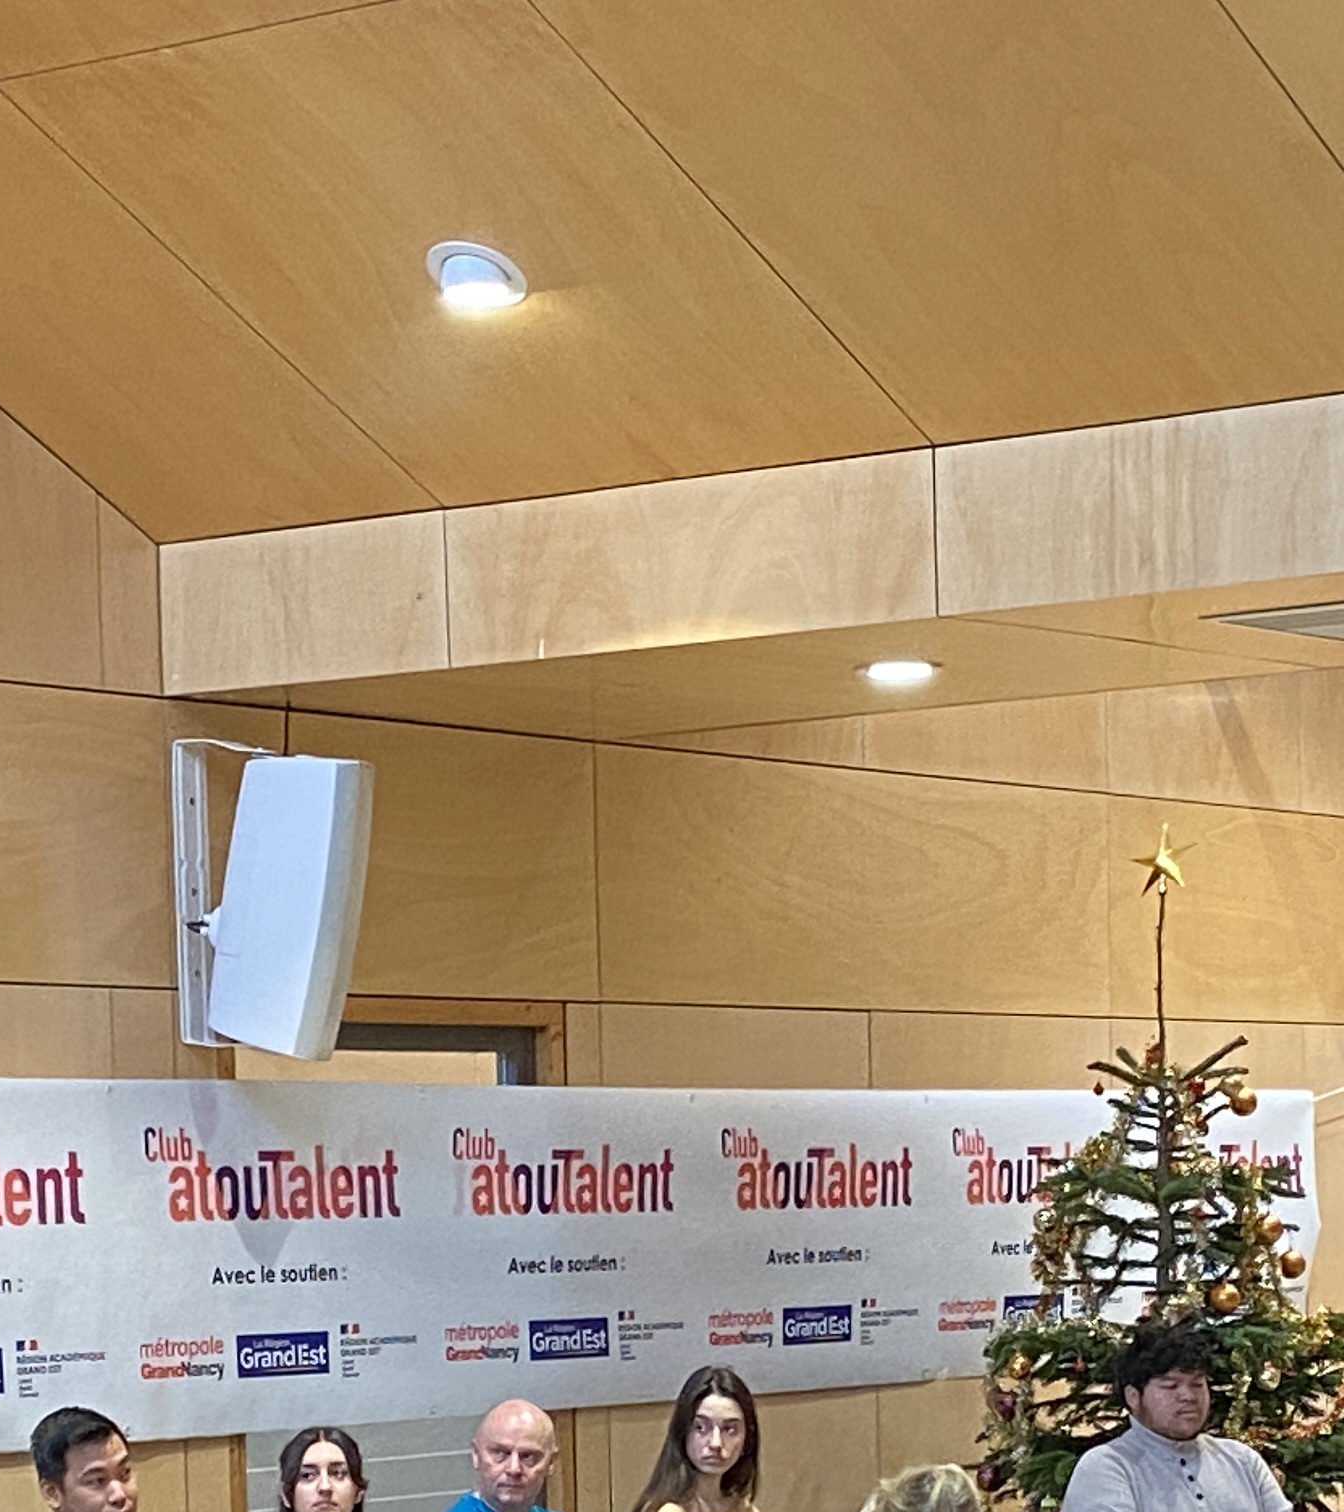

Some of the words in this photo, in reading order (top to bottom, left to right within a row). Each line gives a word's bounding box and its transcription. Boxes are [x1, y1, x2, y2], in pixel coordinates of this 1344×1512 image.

[144, 1127, 193, 1163] Club
[453, 1127, 495, 1160] Club
[721, 1127, 758, 1158] Club
[952, 1127, 985, 1157] Club
[168, 1145, 401, 1221] atouTalent
[471, 1143, 674, 1217] atouTalent
[736, 1143, 913, 1210] atouTalent
[766, 1249, 800, 1266] Avec
[803, 1248, 816, 1264] le
[991, 1240, 1020, 1256] Avec
[212, 1266, 256, 1285] Avec
[261, 1265, 276, 1283] le
[280, 1264, 338, 1283] soutien
[507, 1256, 547, 1275] Avec
[550, 1256, 563, 1274] le
[567, 1254, 617, 1273] soutien
[140, 1335, 224, 1359] métropole
[239, 1344, 296, 1370] Grand
